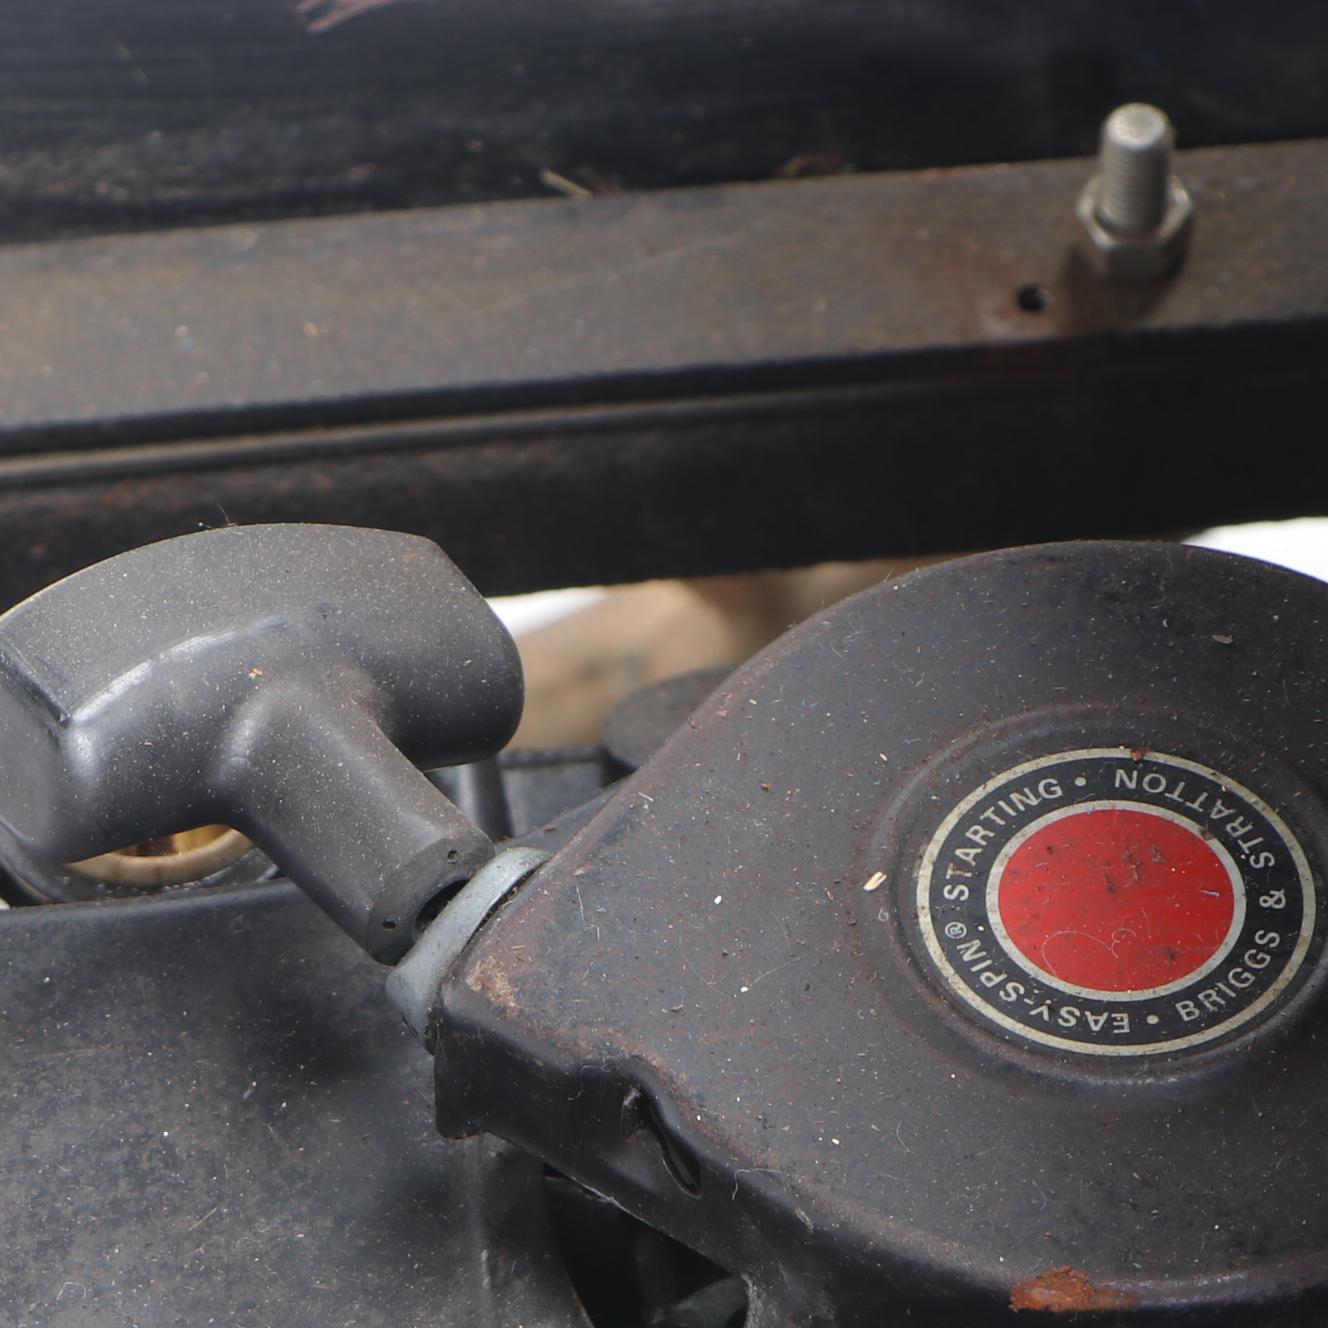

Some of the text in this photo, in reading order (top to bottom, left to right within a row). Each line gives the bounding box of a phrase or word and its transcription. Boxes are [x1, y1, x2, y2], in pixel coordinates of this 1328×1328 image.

[943, 777, 1064, 901] STARTING
[1114, 768, 1286, 1023] BRIGGS & STRATTON
